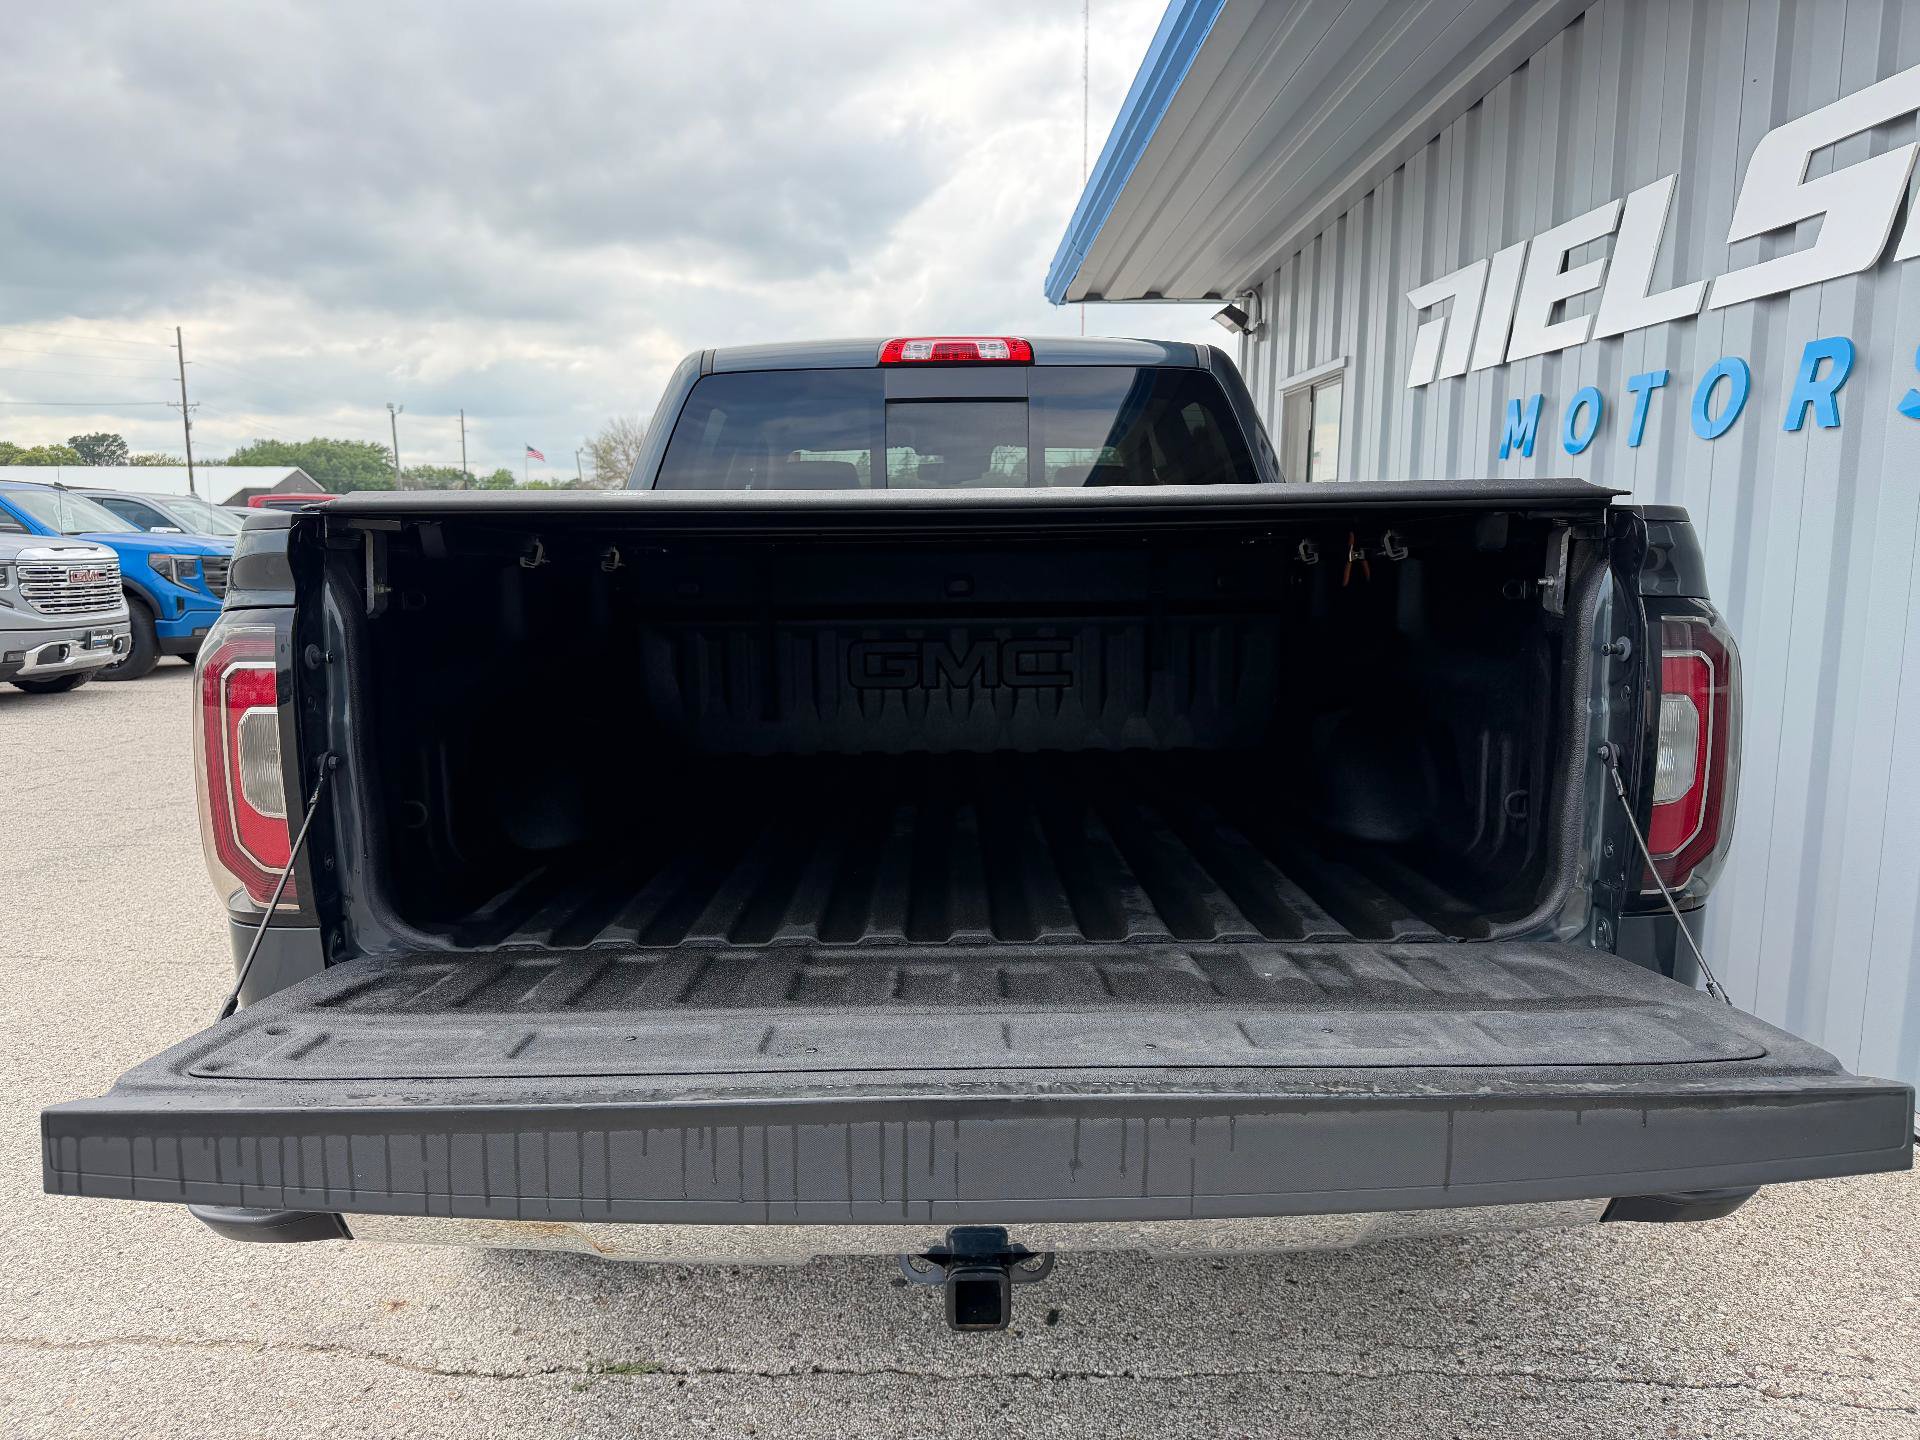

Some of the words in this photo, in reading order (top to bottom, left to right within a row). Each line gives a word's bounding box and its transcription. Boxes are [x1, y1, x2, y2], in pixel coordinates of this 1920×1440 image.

[1406, 64, 1920, 389] NIELS
[70, 569, 107, 583] GMC
[848, 637, 1073, 690] GMC
